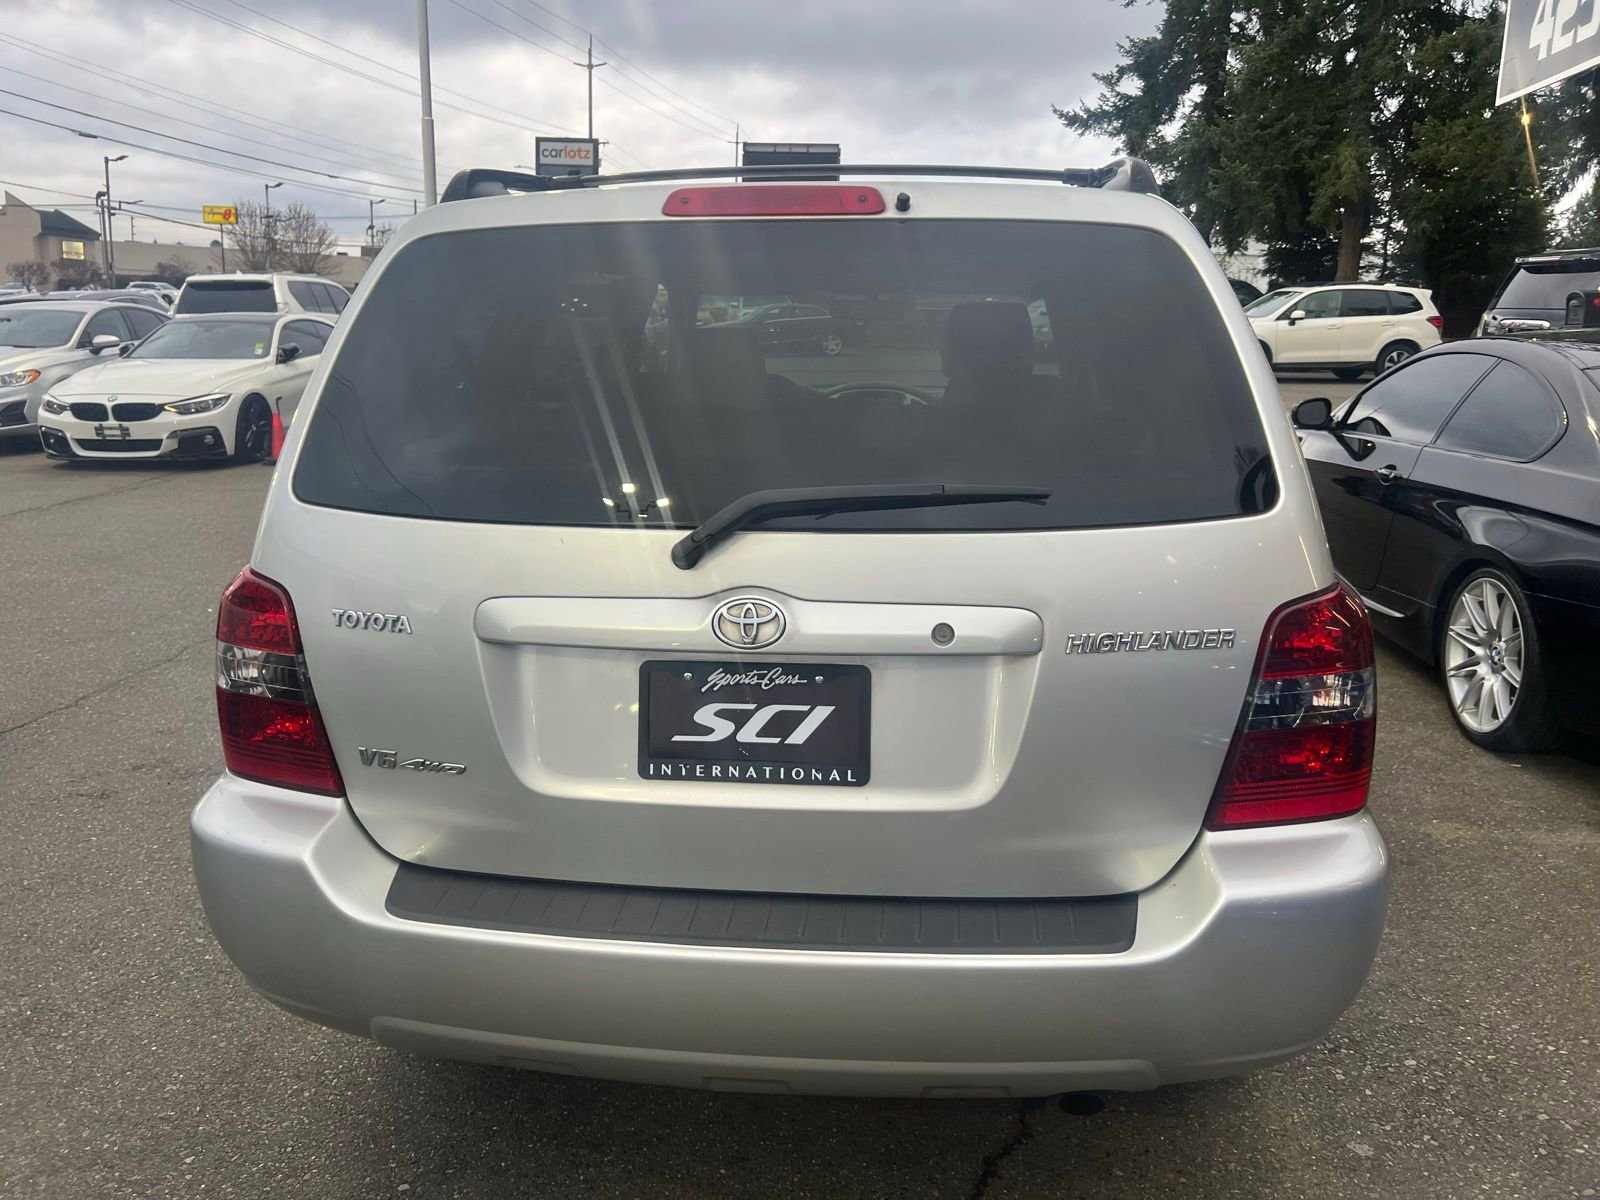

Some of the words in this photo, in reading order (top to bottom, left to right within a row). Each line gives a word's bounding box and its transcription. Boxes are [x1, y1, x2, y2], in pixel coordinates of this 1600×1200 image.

[541, 145, 591, 160] carlotz
[331, 608, 413, 634] TOYOTA
[1065, 628, 1237, 654] HIGHLANDER
[701, 668, 765, 693] Sports
[761, 667, 808, 690] Cars
[670, 702, 836, 745] SCI
[358, 746, 397, 770] V6
[399, 757, 467, 775] 4WD
[649, 763, 857, 782] INTERNATIONAL
